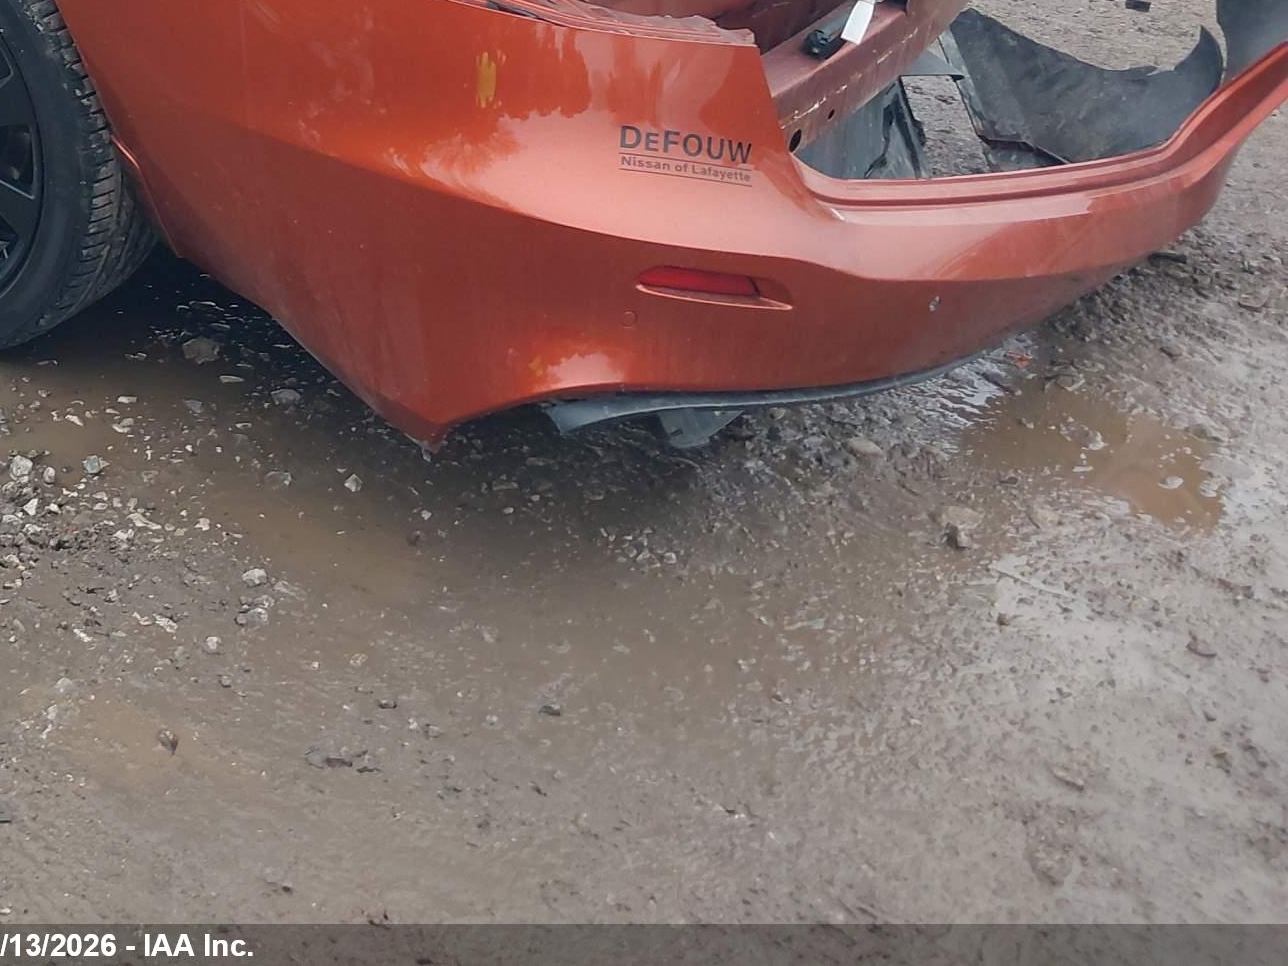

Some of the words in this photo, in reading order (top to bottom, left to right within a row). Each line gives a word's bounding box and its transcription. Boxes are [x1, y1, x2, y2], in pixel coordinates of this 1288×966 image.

[620, 156, 670, 171] Nissan
[675, 161, 688, 174] of
[691, 165, 752, 183] Lafayette
